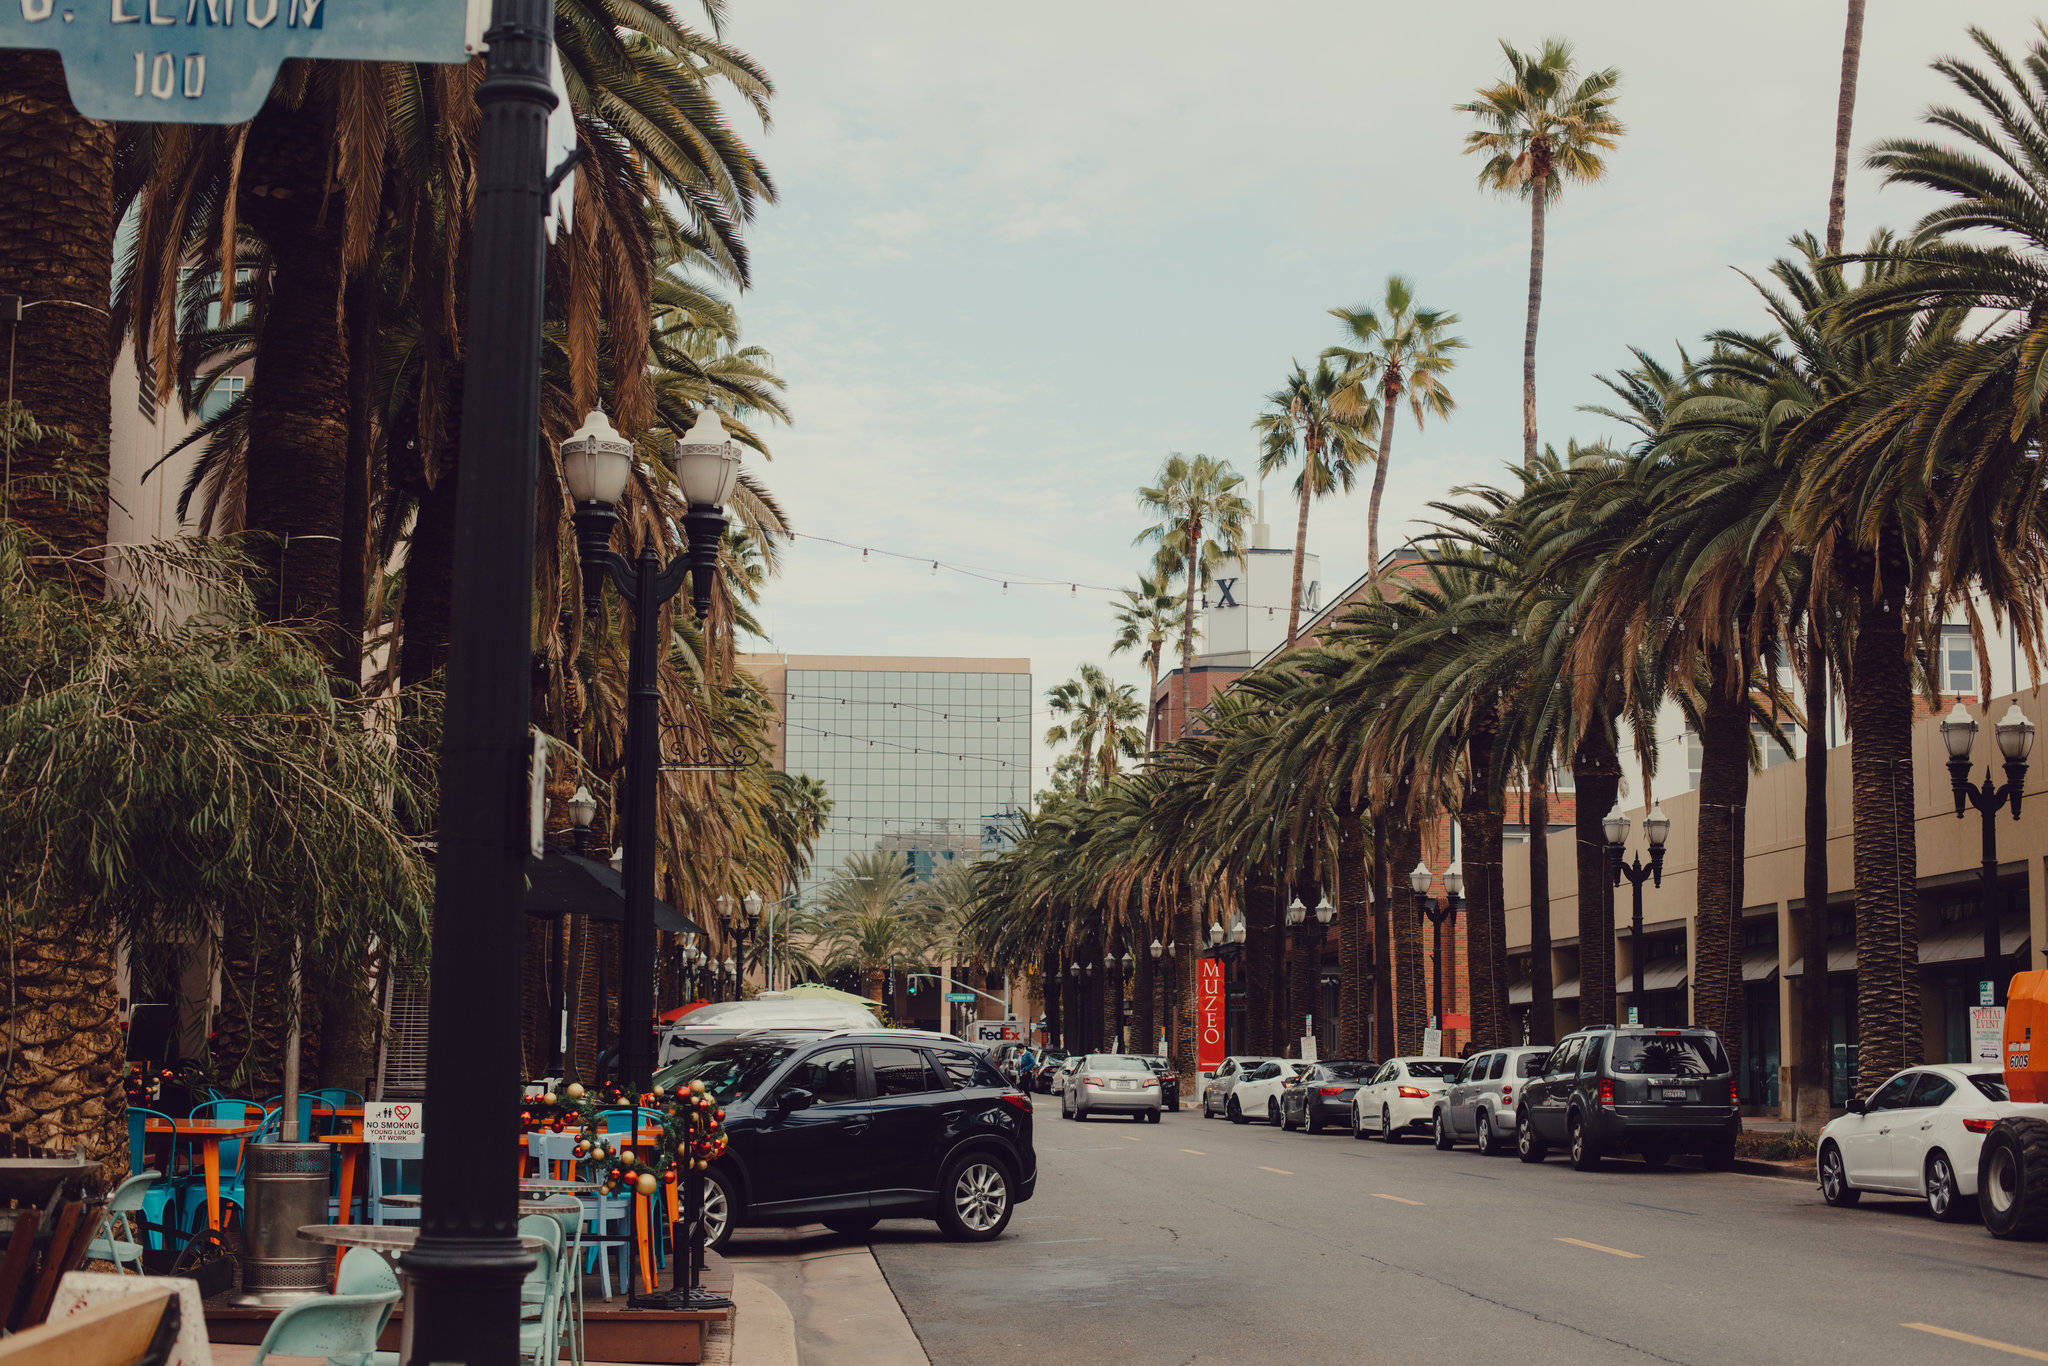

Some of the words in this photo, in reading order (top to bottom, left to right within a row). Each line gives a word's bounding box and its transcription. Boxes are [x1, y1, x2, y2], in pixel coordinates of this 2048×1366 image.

[134, 51, 206, 99] 100
[1203, 962, 1220, 1044] MUZEO
[1972, 1009, 2001, 1019] SPECIAL
[1976, 1019, 2000, 1029] EVENT
[978, 1027, 1021, 1041] FedEx
[2009, 1054, 2029, 1068] 600S
